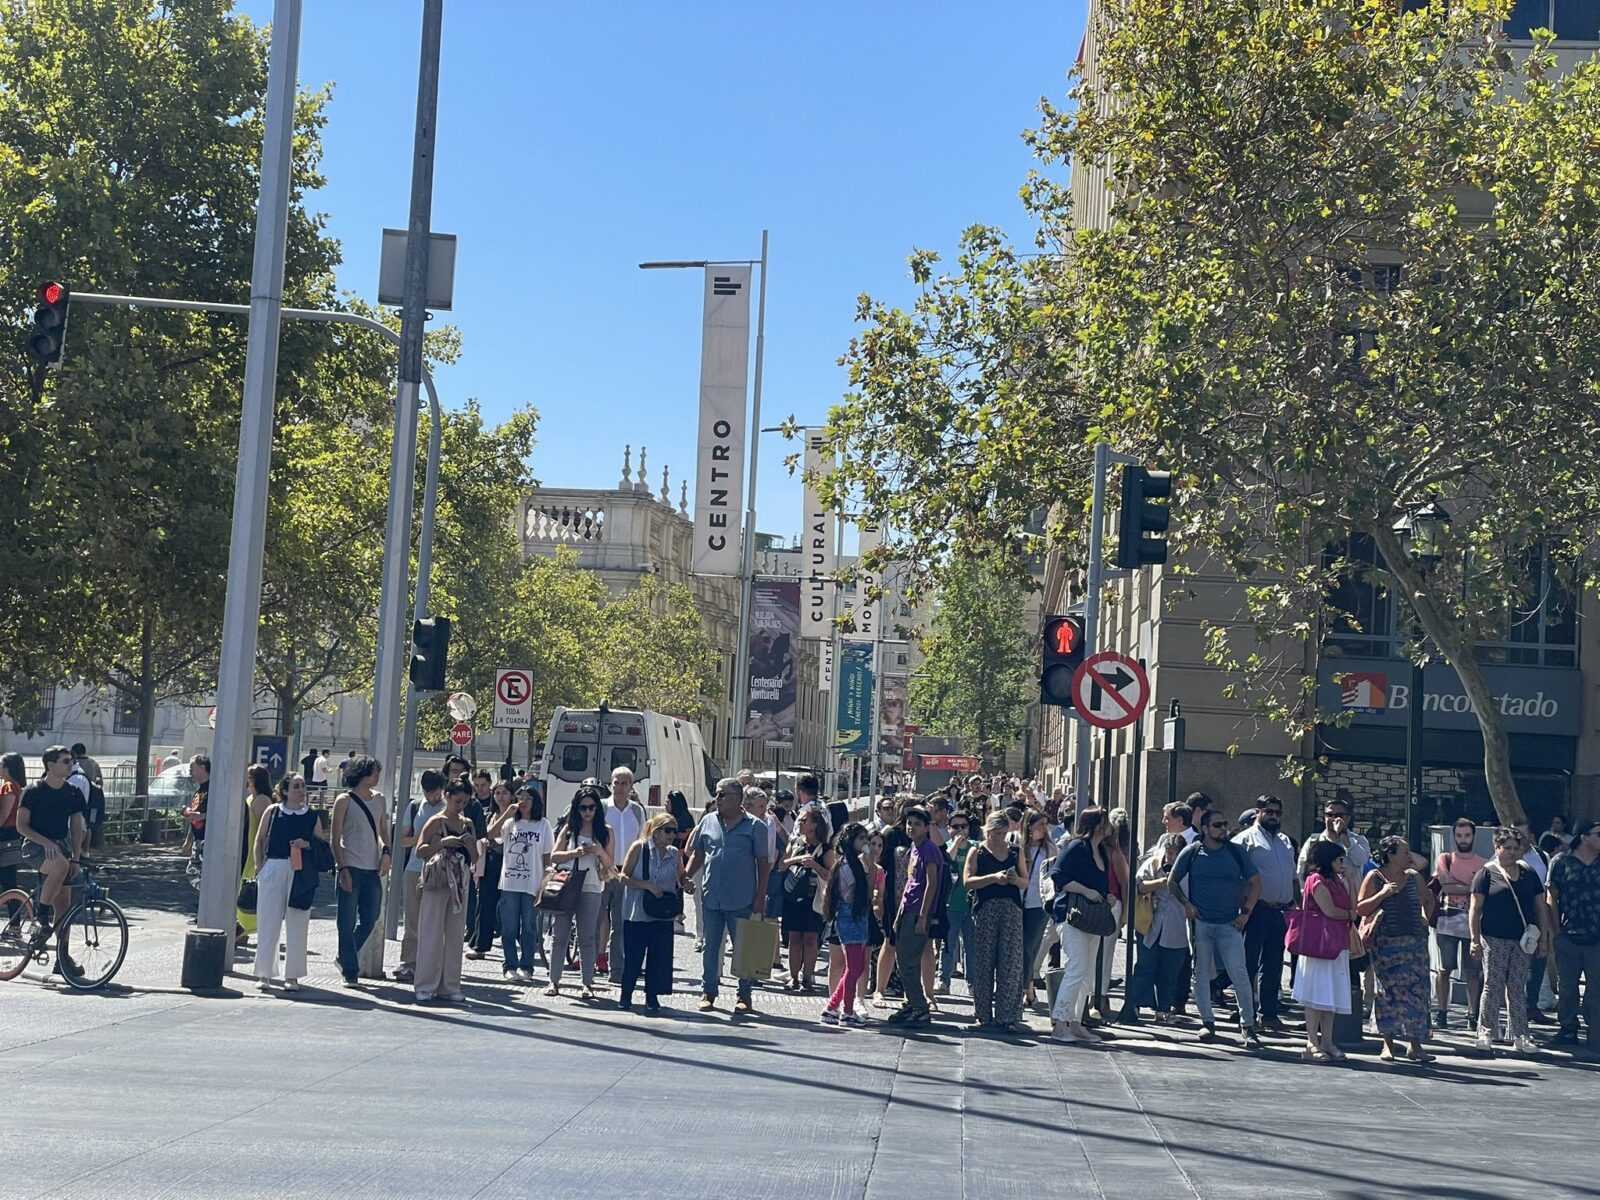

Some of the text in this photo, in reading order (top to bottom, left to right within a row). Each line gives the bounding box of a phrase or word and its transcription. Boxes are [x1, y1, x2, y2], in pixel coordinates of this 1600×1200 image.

[707, 419, 731, 552] CENTRO
[811, 512, 826, 622] CULTURAL
[862, 571, 874, 633] MOND
[825, 640, 833, 681] CENTR
[751, 675, 783, 689] Centenario
[750, 687, 780, 701] Venturelli
[1388, 683, 1559, 718] Bncotado
[495, 717, 529, 725] LA CUADRA
[505, 707, 520, 715] TODA
[452, 730, 471, 739] PARE
[257, 746, 269, 768] E
